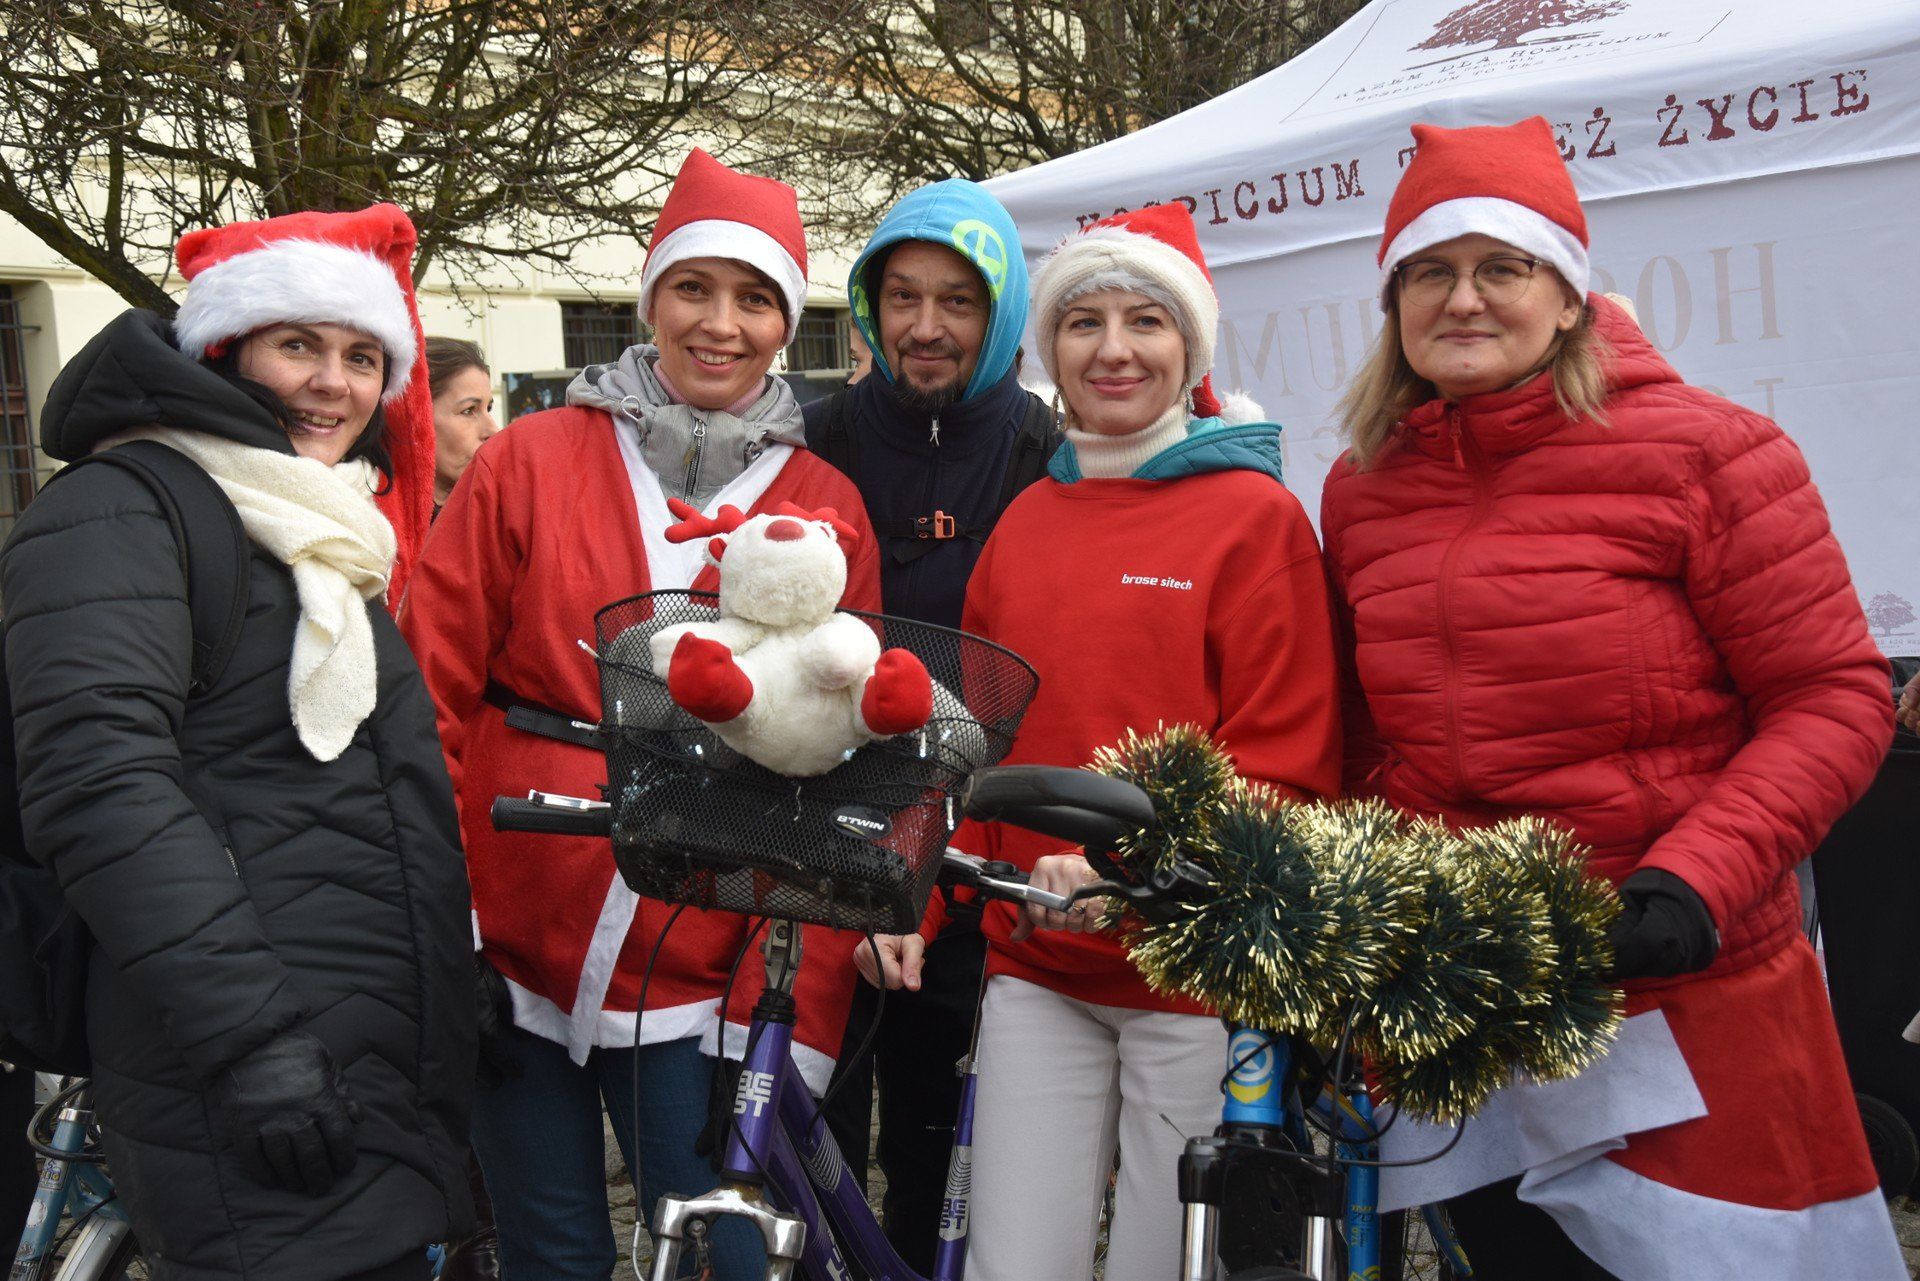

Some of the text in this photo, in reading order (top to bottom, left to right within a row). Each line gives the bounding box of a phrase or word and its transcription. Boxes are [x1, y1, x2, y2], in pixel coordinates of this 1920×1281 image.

[1440, 56, 1490, 74] DLA
[1509, 30, 1673, 59] HOSPICJUM
[1656, 69, 1870, 148] ŻYCIE
[1074, 159, 1365, 231] ICJUM
[1121, 573, 1193, 591] brose sitech
